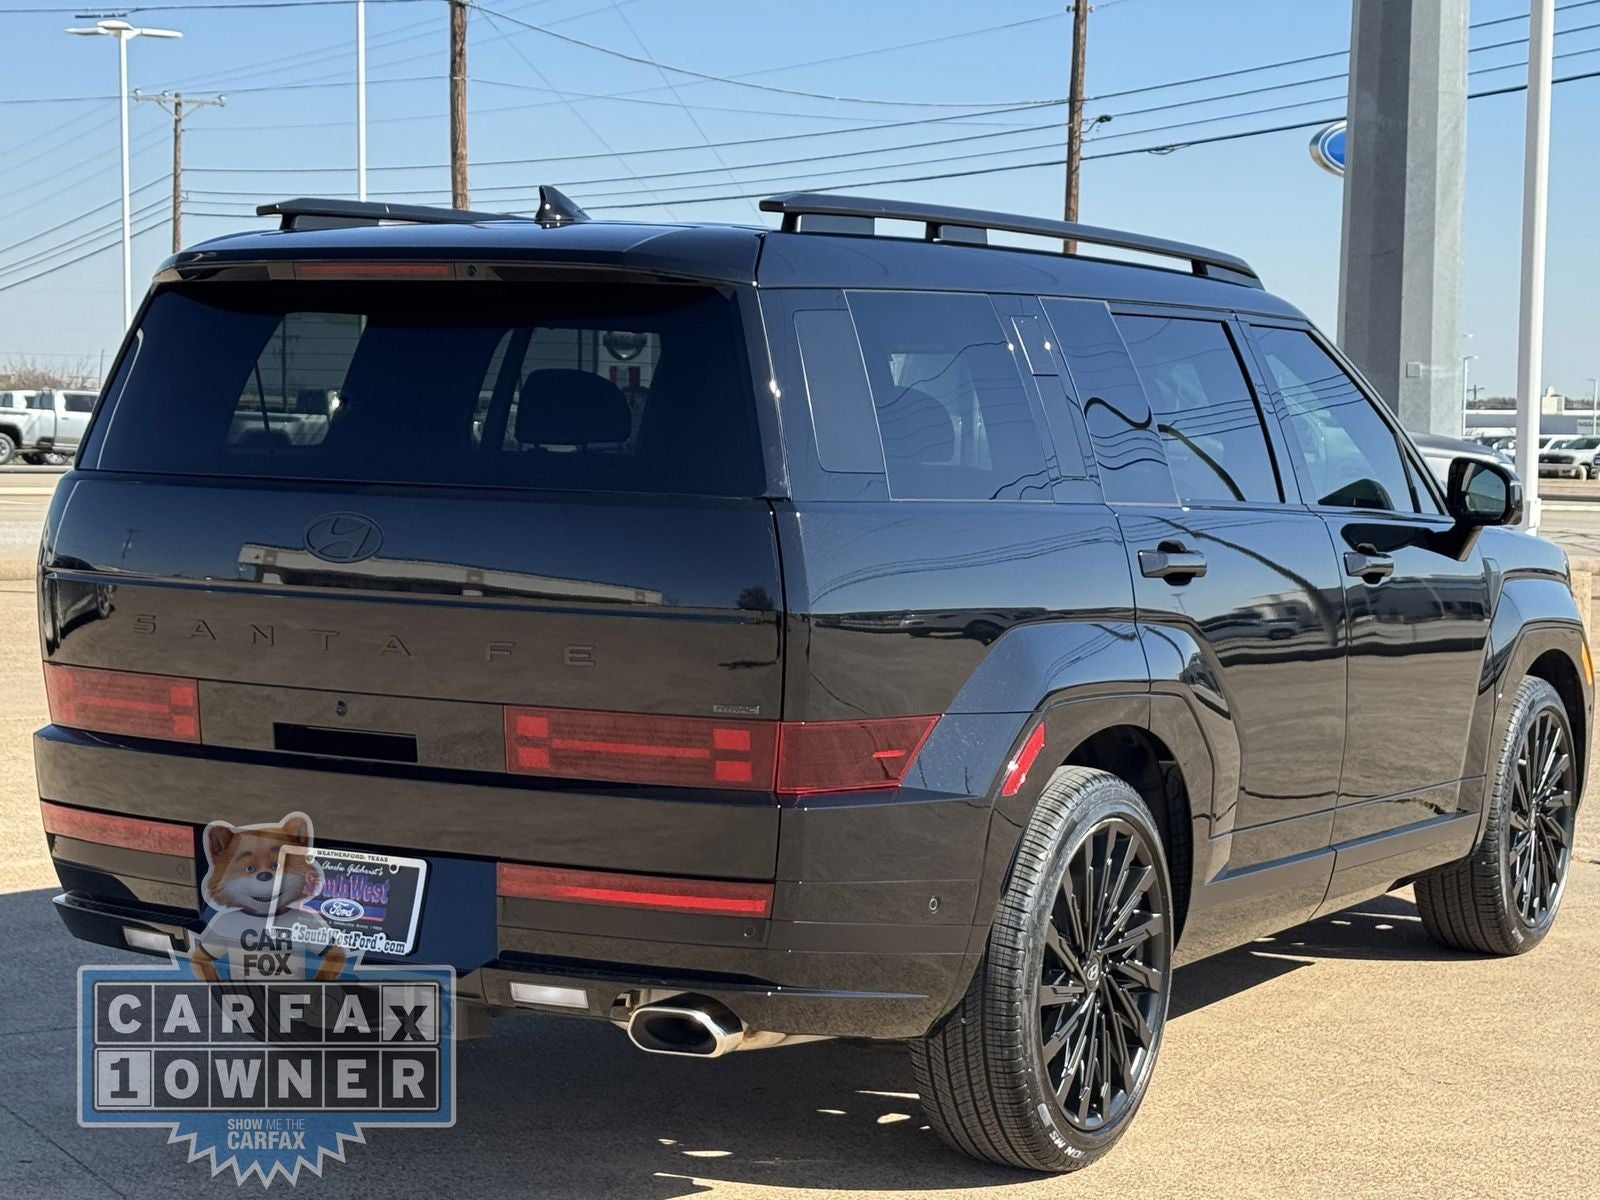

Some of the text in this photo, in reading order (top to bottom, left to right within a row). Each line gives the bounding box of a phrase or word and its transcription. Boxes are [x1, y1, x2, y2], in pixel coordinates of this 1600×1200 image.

[131, 613, 597, 667] SANTA FE
[368, 855, 388, 863] TEXAS
[302, 870, 390, 904] SuthWest
[328, 901, 354, 918] Ford
